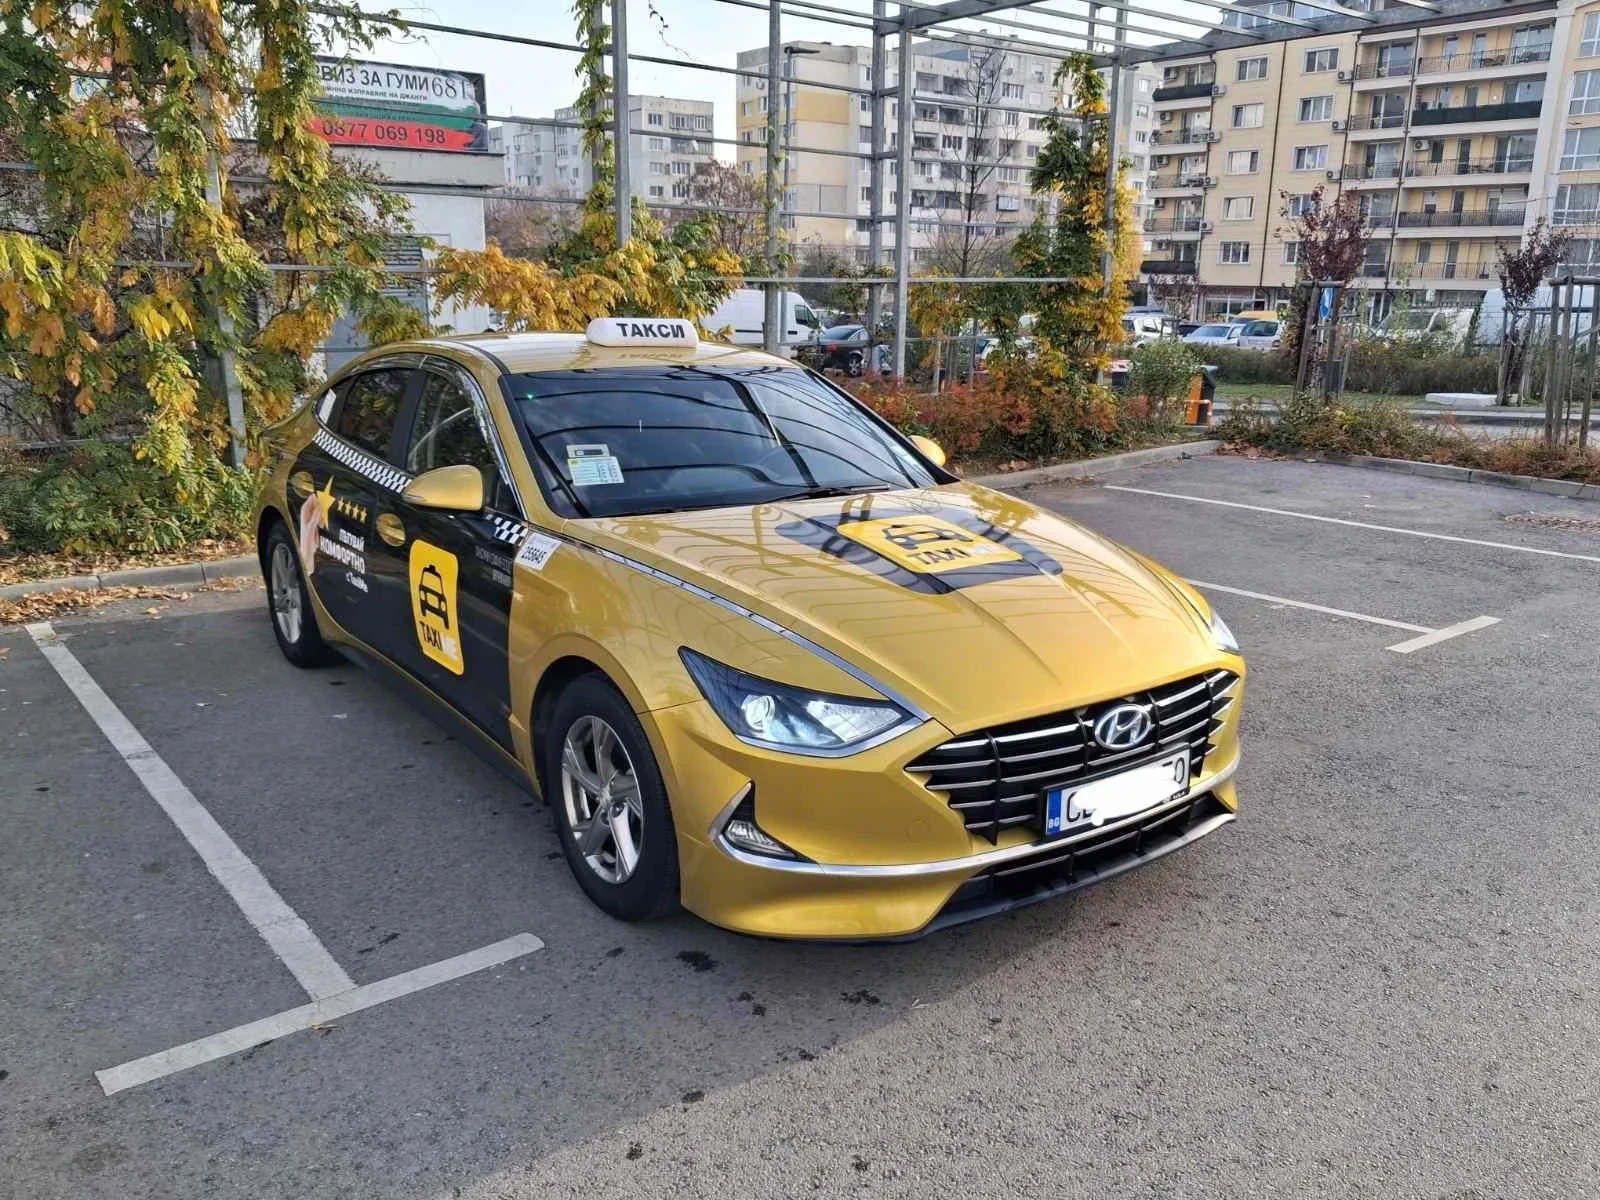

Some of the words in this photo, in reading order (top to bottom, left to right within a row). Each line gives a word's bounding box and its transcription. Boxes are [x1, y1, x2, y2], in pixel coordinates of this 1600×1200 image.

[360, 70, 382, 87] ЗА
[387, 73, 429, 91] ГУМИ
[322, 119, 367, 138] 0877
[375, 125, 408, 141] 069
[415, 129, 446, 144] 198
[616, 323, 685, 338] ТАКСИ
[907, 547, 971, 565] TAXI
[419, 620, 443, 652] TAXI
[1048, 817, 1060, 829] BG
